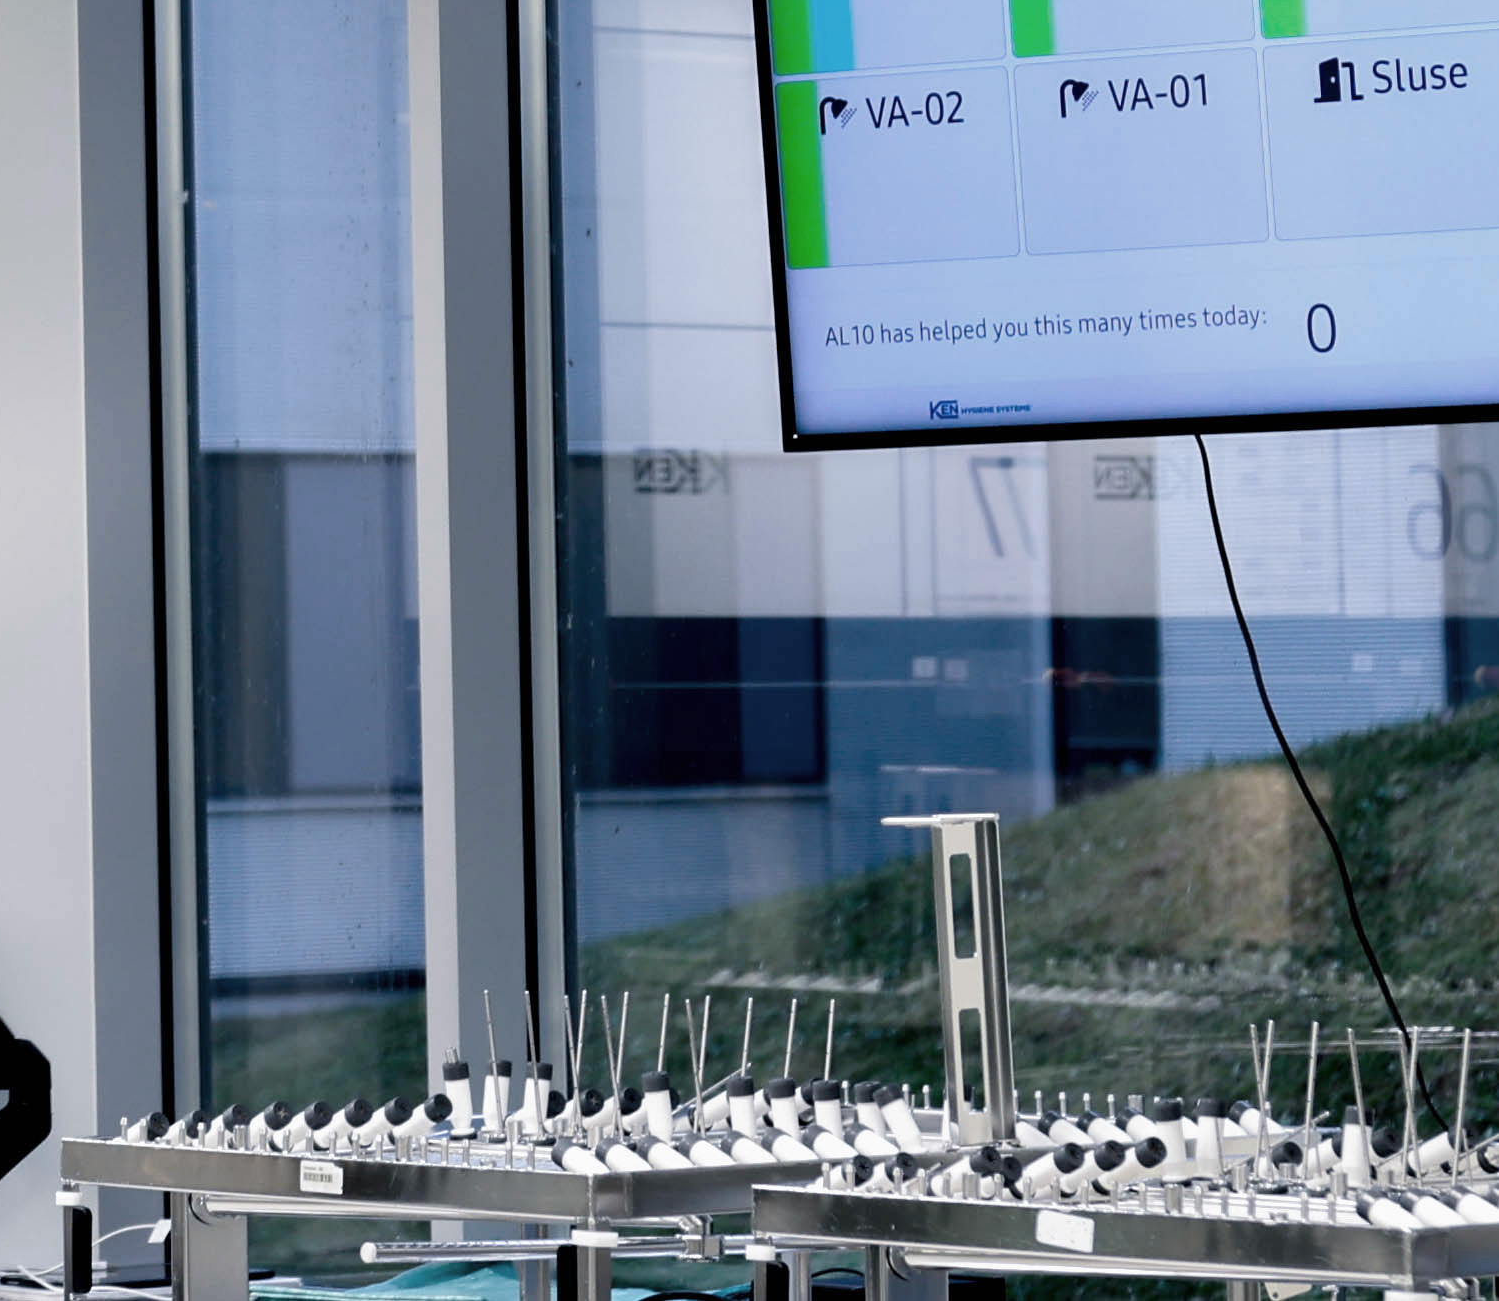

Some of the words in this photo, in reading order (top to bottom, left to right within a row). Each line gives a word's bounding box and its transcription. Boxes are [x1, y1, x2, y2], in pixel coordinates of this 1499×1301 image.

[1108, 74, 1209, 112] VA-01
[1372, 58, 1468, 94] Sluse
[865, 91, 965, 129] VA-02
[825, 325, 875, 347] AL10
[880, 322, 915, 344] has
[919, 317, 988, 347] helped
[993, 320, 1029, 344] you
[1034, 313, 1072, 336] this
[1077, 313, 1133, 339] many
[1139, 308, 1197, 332] times
[1203, 305, 1268, 334] today:
[1307, 303, 1337, 353] 0
[929, 400, 959, 420] KEN
